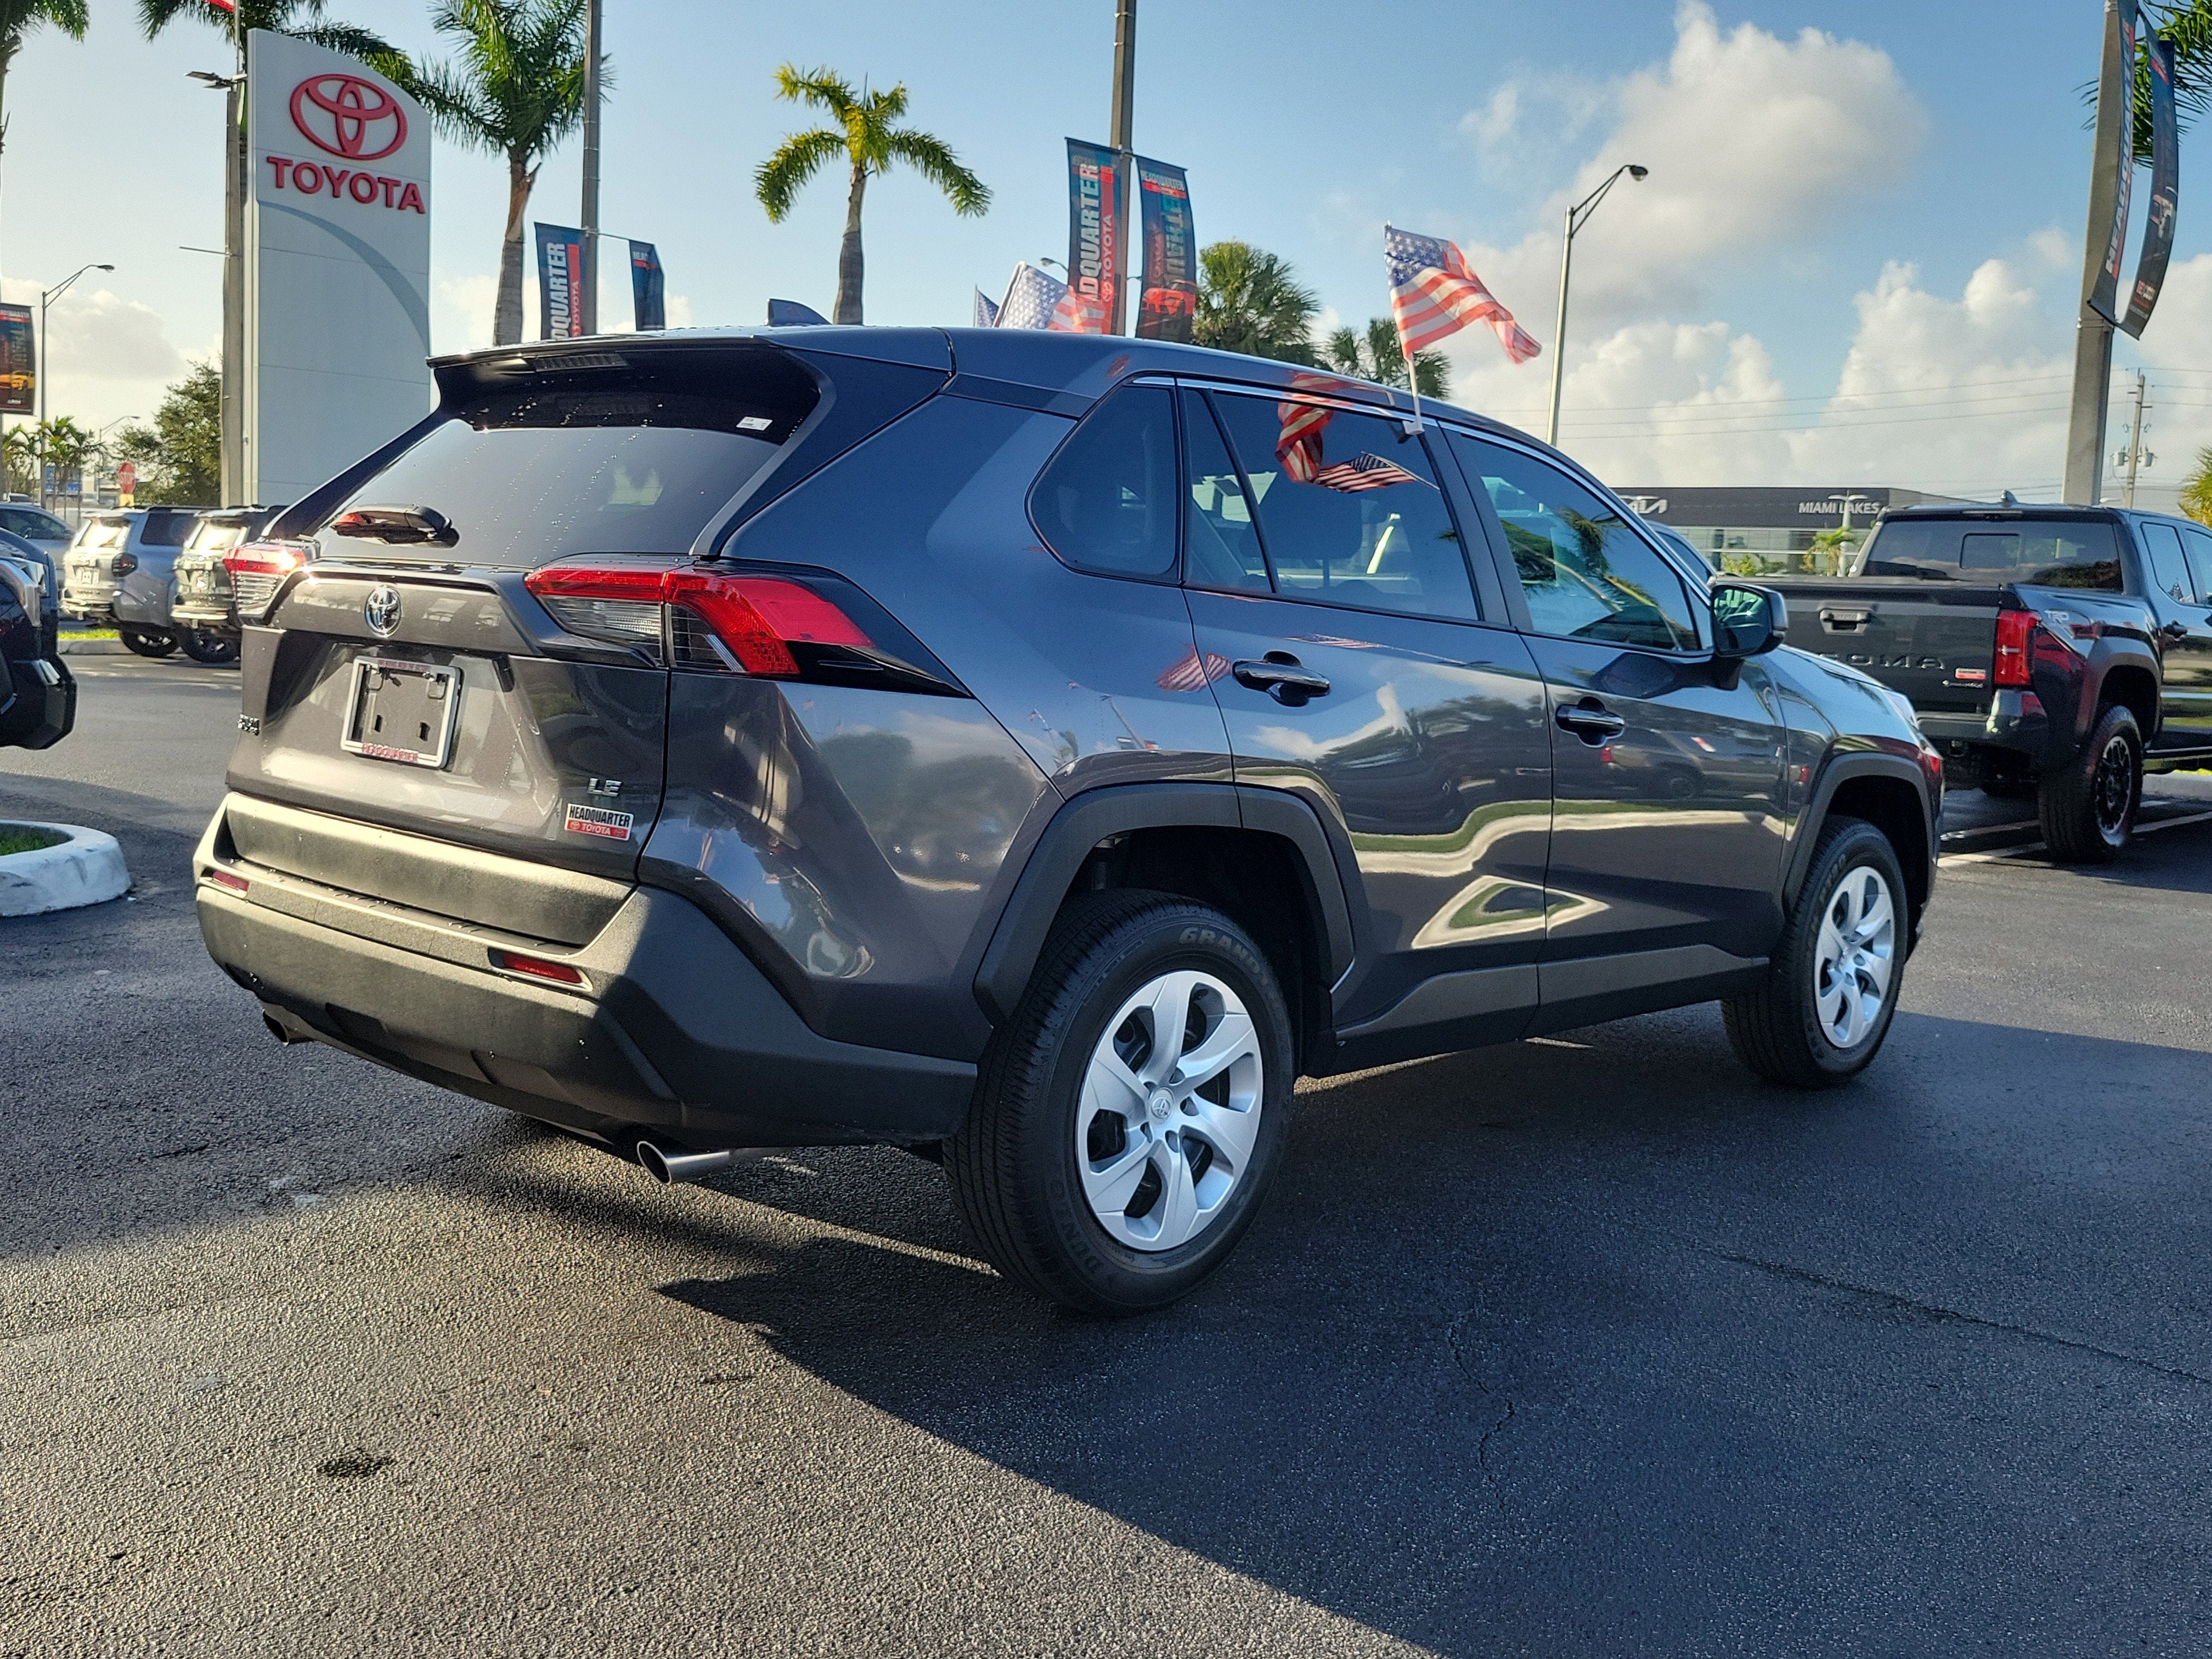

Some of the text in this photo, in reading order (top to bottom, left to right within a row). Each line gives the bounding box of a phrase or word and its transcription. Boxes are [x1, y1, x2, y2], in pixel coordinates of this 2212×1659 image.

[266, 156, 426, 215] TOYOTA
[1103, 215, 1113, 280] TOYOTA
[571, 281, 580, 327] TOYOTA
[1799, 501, 1881, 515] MIAMI LAKES
[587, 777, 622, 797] LE
[569, 805, 631, 828] HEADQUARTER
[582, 822, 611, 836] TOYOTA
